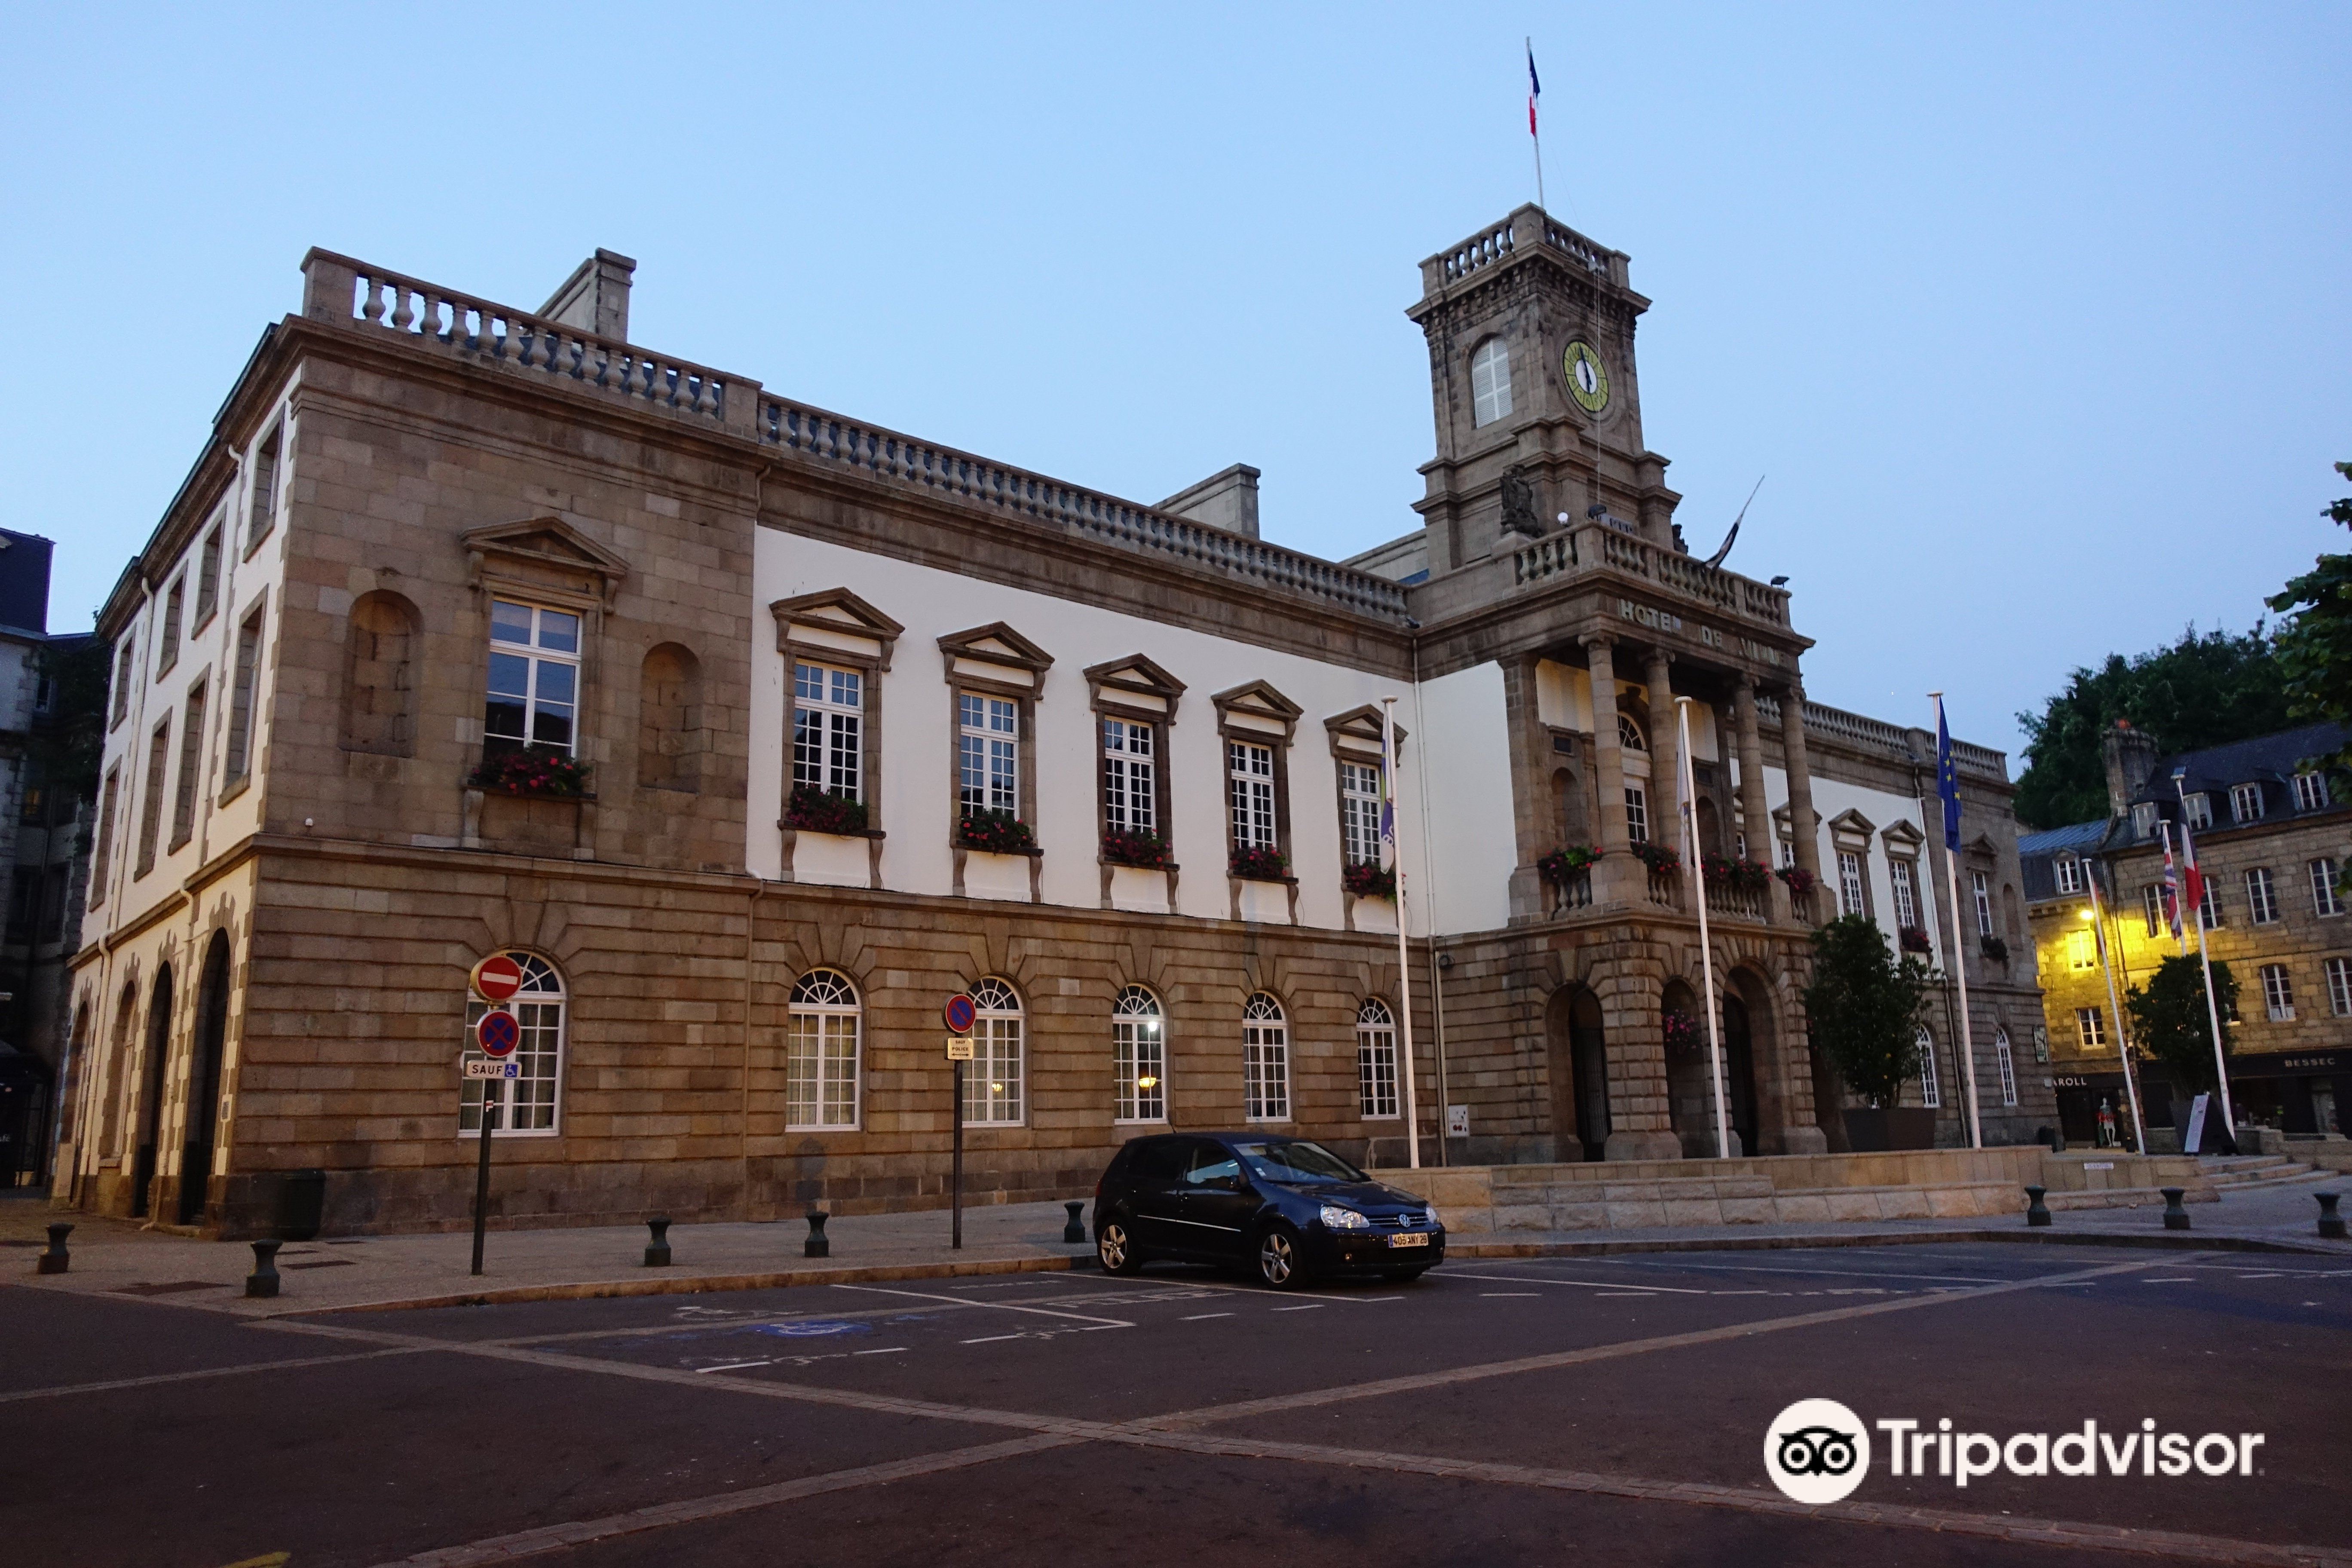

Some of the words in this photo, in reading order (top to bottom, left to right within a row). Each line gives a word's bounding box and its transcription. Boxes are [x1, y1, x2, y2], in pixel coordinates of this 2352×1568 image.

[1701, 625, 1723, 647] DE
[2284, 1057, 2336, 1068] BESSEC
[472, 1064, 503, 1075] SAUF
[1408, 1235, 1419, 1245] ANY
